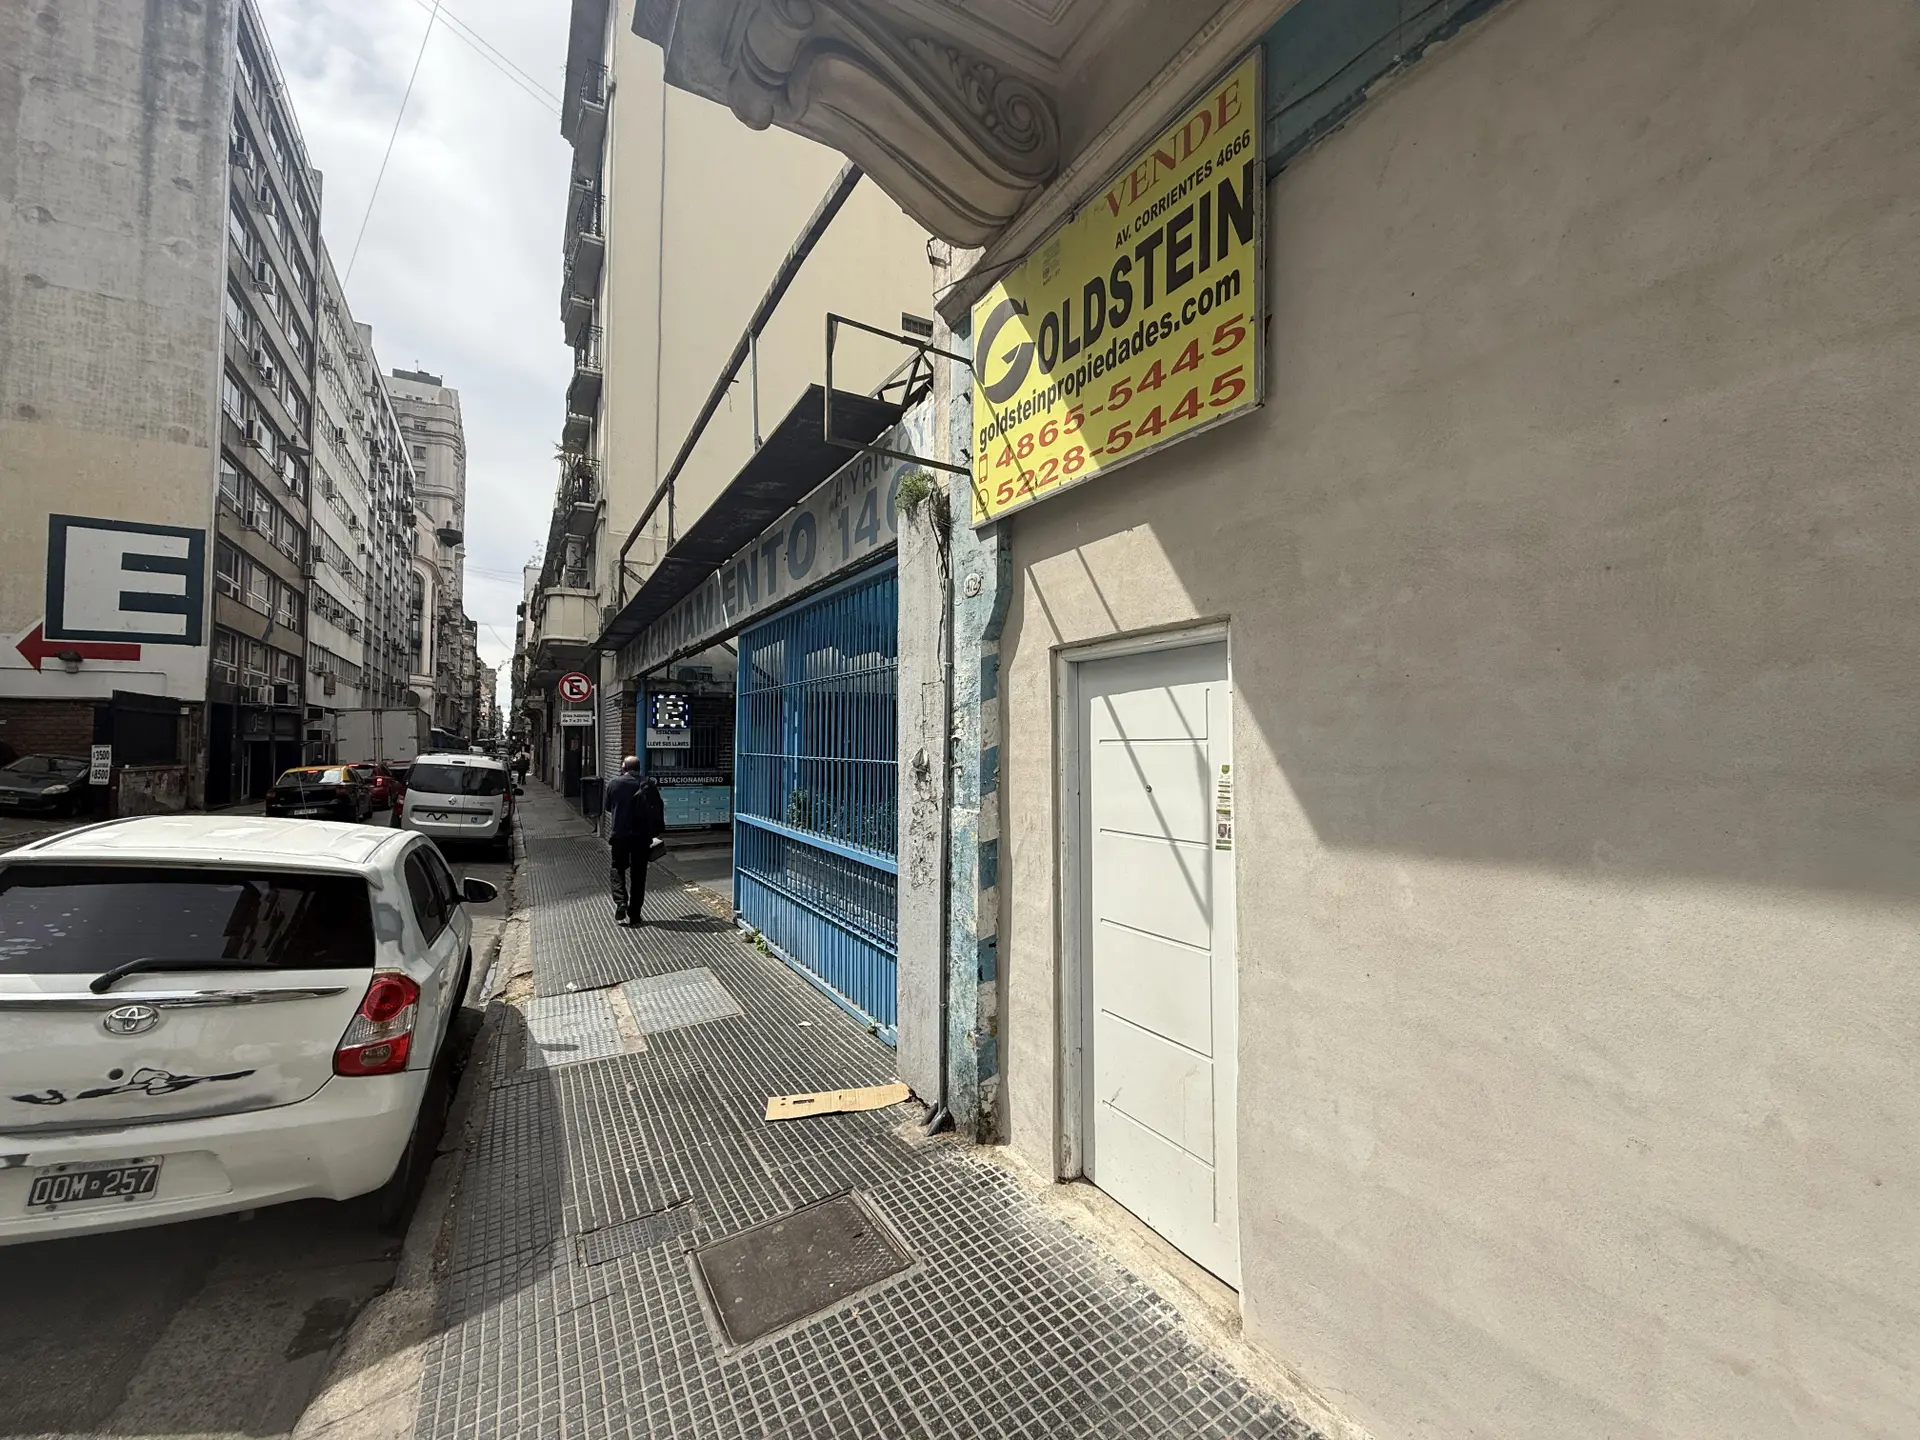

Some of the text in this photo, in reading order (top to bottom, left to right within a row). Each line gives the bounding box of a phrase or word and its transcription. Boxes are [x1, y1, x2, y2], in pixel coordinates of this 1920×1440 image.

[1103, 79, 1243, 219] VENDE
[1114, 129, 1251, 250] AV. CORRIENTES 4666
[975, 157, 1255, 405] GOLDSTEIN
[979, 268, 1241, 452] goldsteinpropiedades.com
[995, 313, 1246, 470] 4865-5445
[995, 365, 1246, 506] 5228-5445
[62, 525, 190, 636] E
[659, 776, 724, 784] ESTACIONAMIENTO
[102, 1167, 156, 1196] 257
